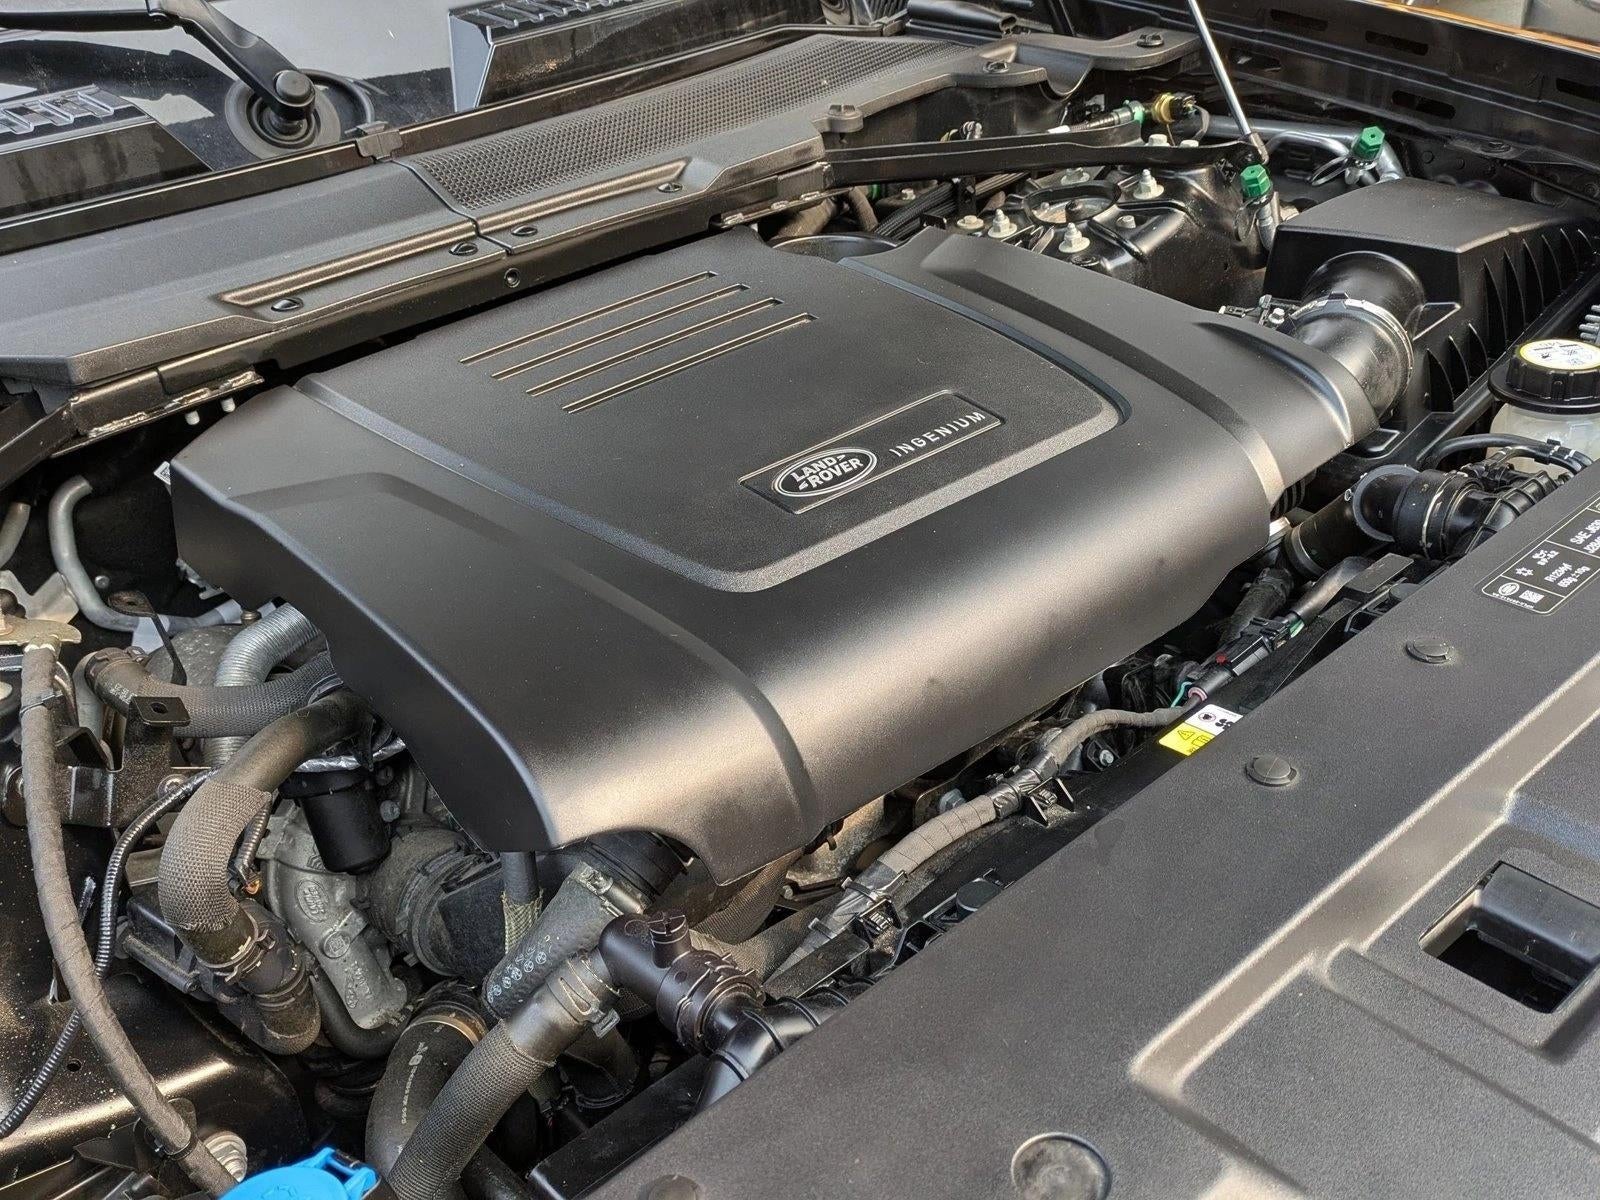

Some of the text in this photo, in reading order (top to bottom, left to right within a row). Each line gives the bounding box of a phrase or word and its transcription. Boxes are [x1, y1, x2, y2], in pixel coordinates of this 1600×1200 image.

[889, 411, 986, 458] INGENIUM
[790, 456, 837, 483] LAND
[806, 457, 864, 489] ROVER
